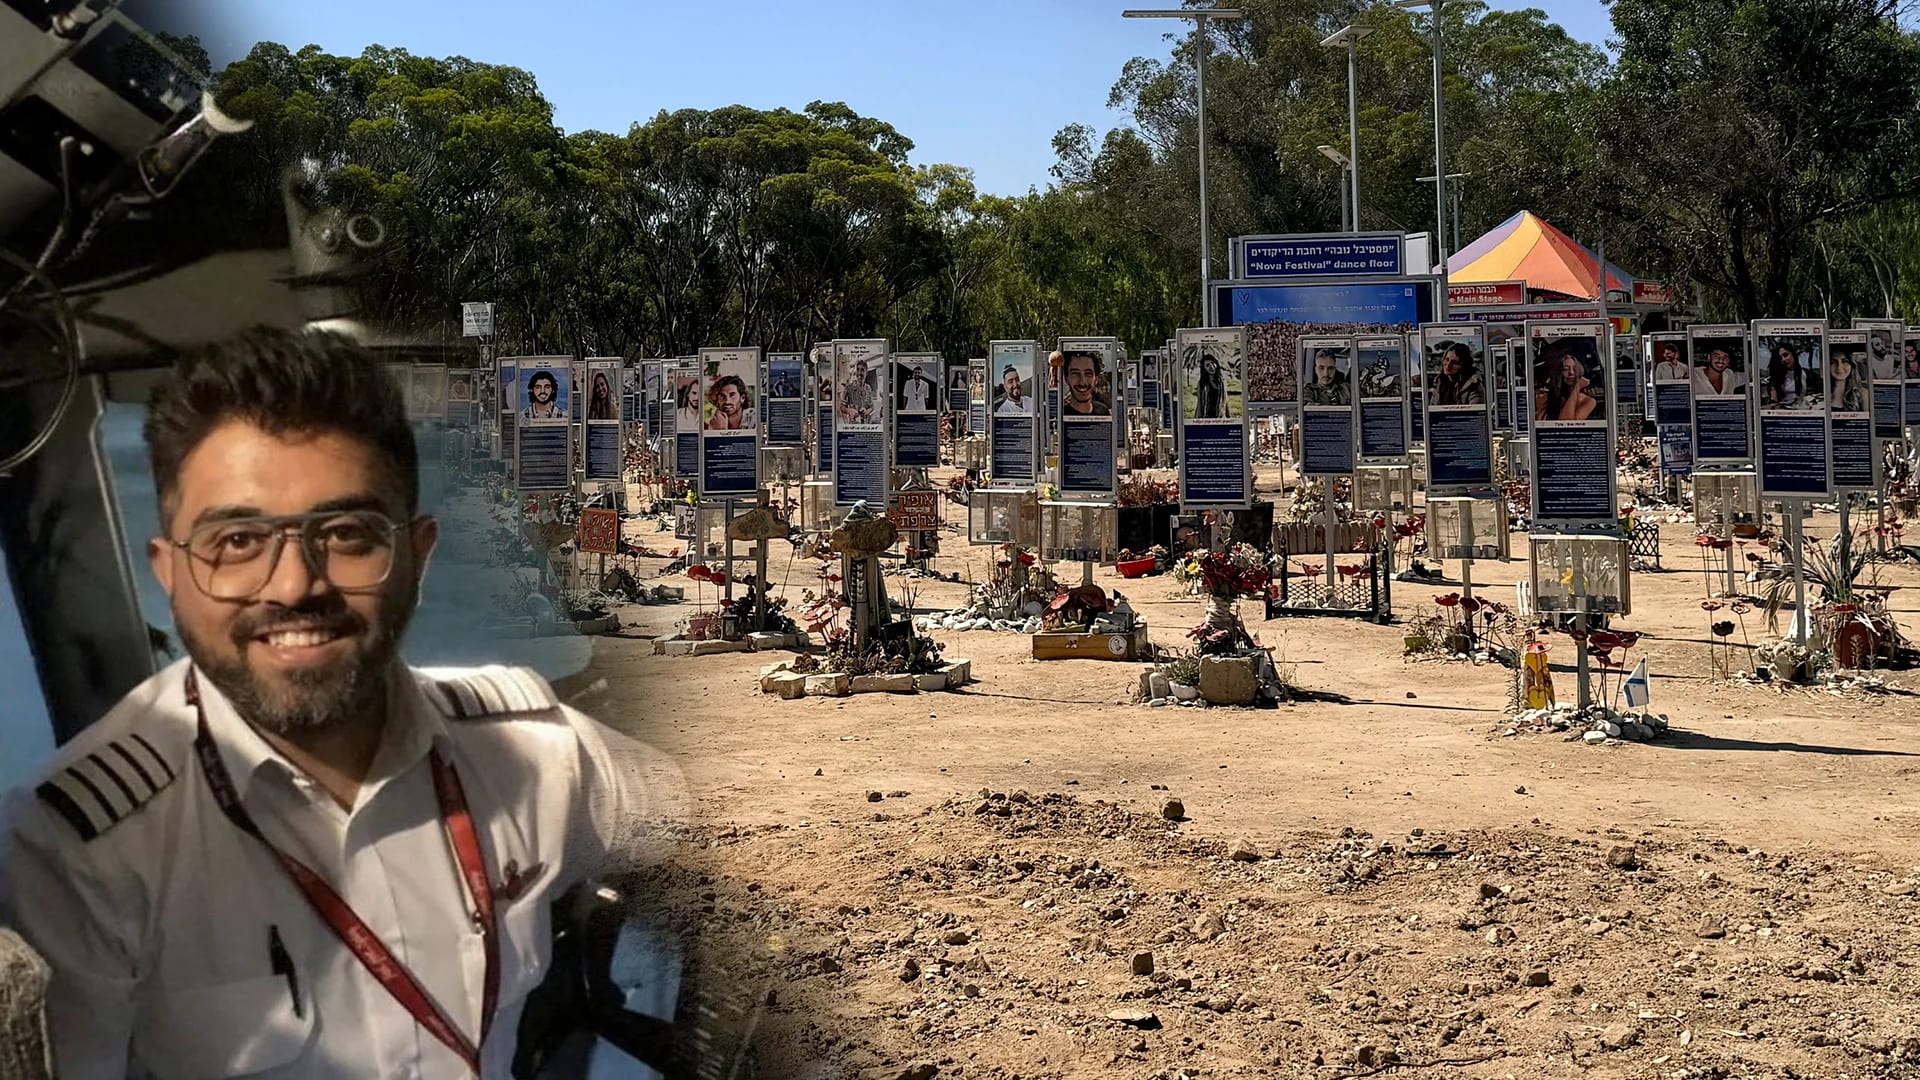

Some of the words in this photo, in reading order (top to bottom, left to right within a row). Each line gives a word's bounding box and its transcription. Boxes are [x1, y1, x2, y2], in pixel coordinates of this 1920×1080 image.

[1251, 248, 1294, 258] הריקודים
[1296, 247, 1321, 256] רחבת
[1333, 260, 1366, 268] dance
[1369, 259, 1394, 268] floor
[1476, 286, 1496, 294] הבמה
[1478, 295, 1503, 303] Stage
[899, 495, 934, 506] אופיר
